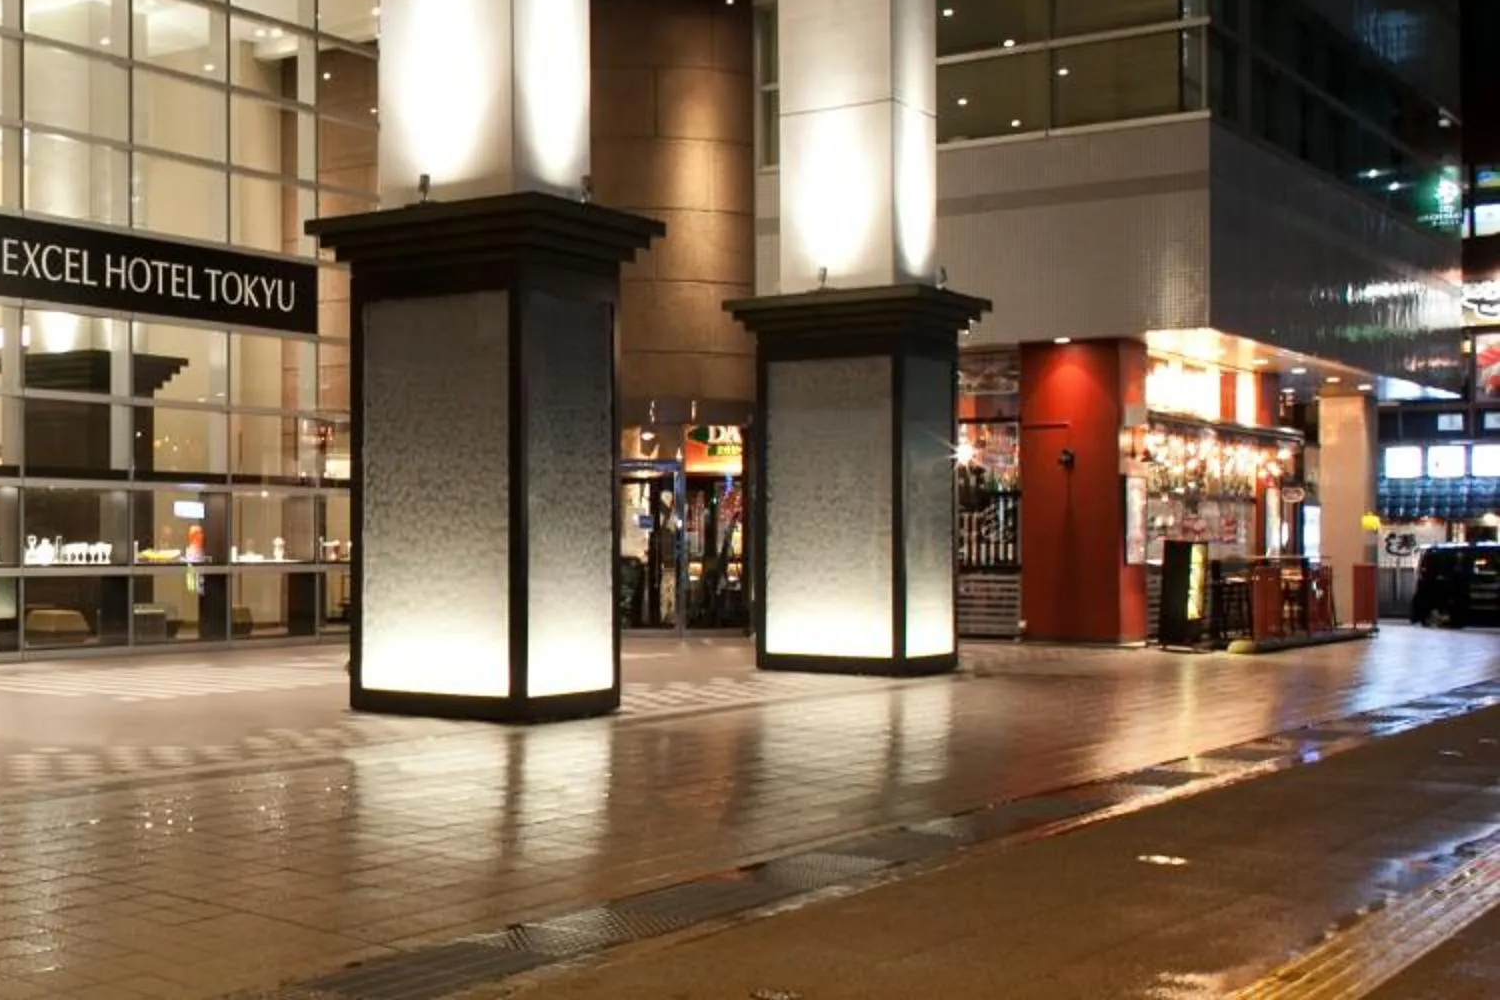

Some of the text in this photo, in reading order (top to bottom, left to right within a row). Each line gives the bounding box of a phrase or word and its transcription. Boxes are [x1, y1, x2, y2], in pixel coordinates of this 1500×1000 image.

[2, 238, 296, 313] EXCEL HOTEL TOKYU
